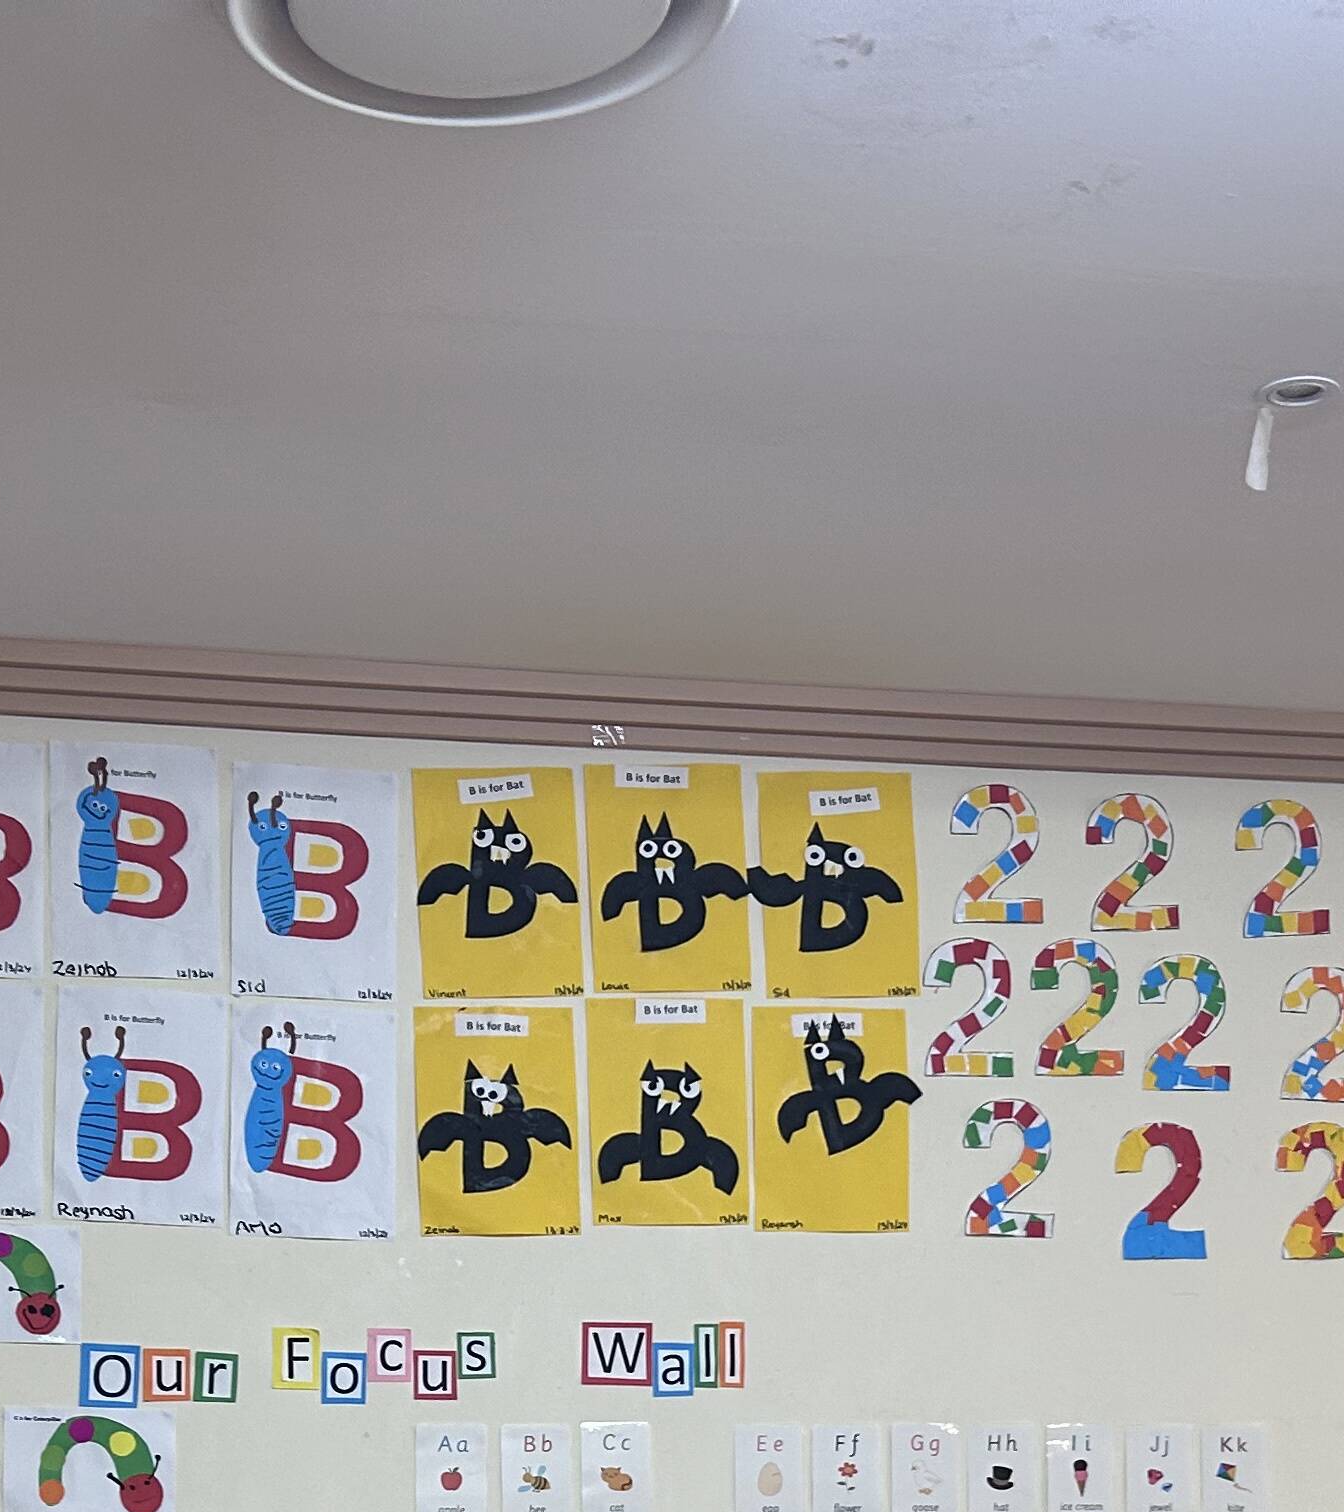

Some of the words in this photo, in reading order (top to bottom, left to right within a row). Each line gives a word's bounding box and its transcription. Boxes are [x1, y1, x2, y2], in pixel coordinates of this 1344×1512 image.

[468, 786, 476, 795] B
[478, 785, 486, 794] is
[487, 783, 503, 793] for
[506, 780, 524, 791] Bat
[626, 773, 633, 782] B
[636, 773, 643, 782] is
[645, 773, 661, 783] for
[663, 774, 681, 784] Bat
[950, 784, 1043, 923] 2
[1235, 799, 1330, 938] 2
[132, 1015, 165, 1026] Butterfly
[1138, 954, 1231, 1090] 2
[1115, 1122, 1207, 1260] 2
[93, 1353, 227, 1398] Our
[287, 1336, 486, 1396] Focus
[592, 1330, 737, 1387] Wall
[609, 1503, 625, 1512] cat
[993, 1503, 1009, 1512] hat
